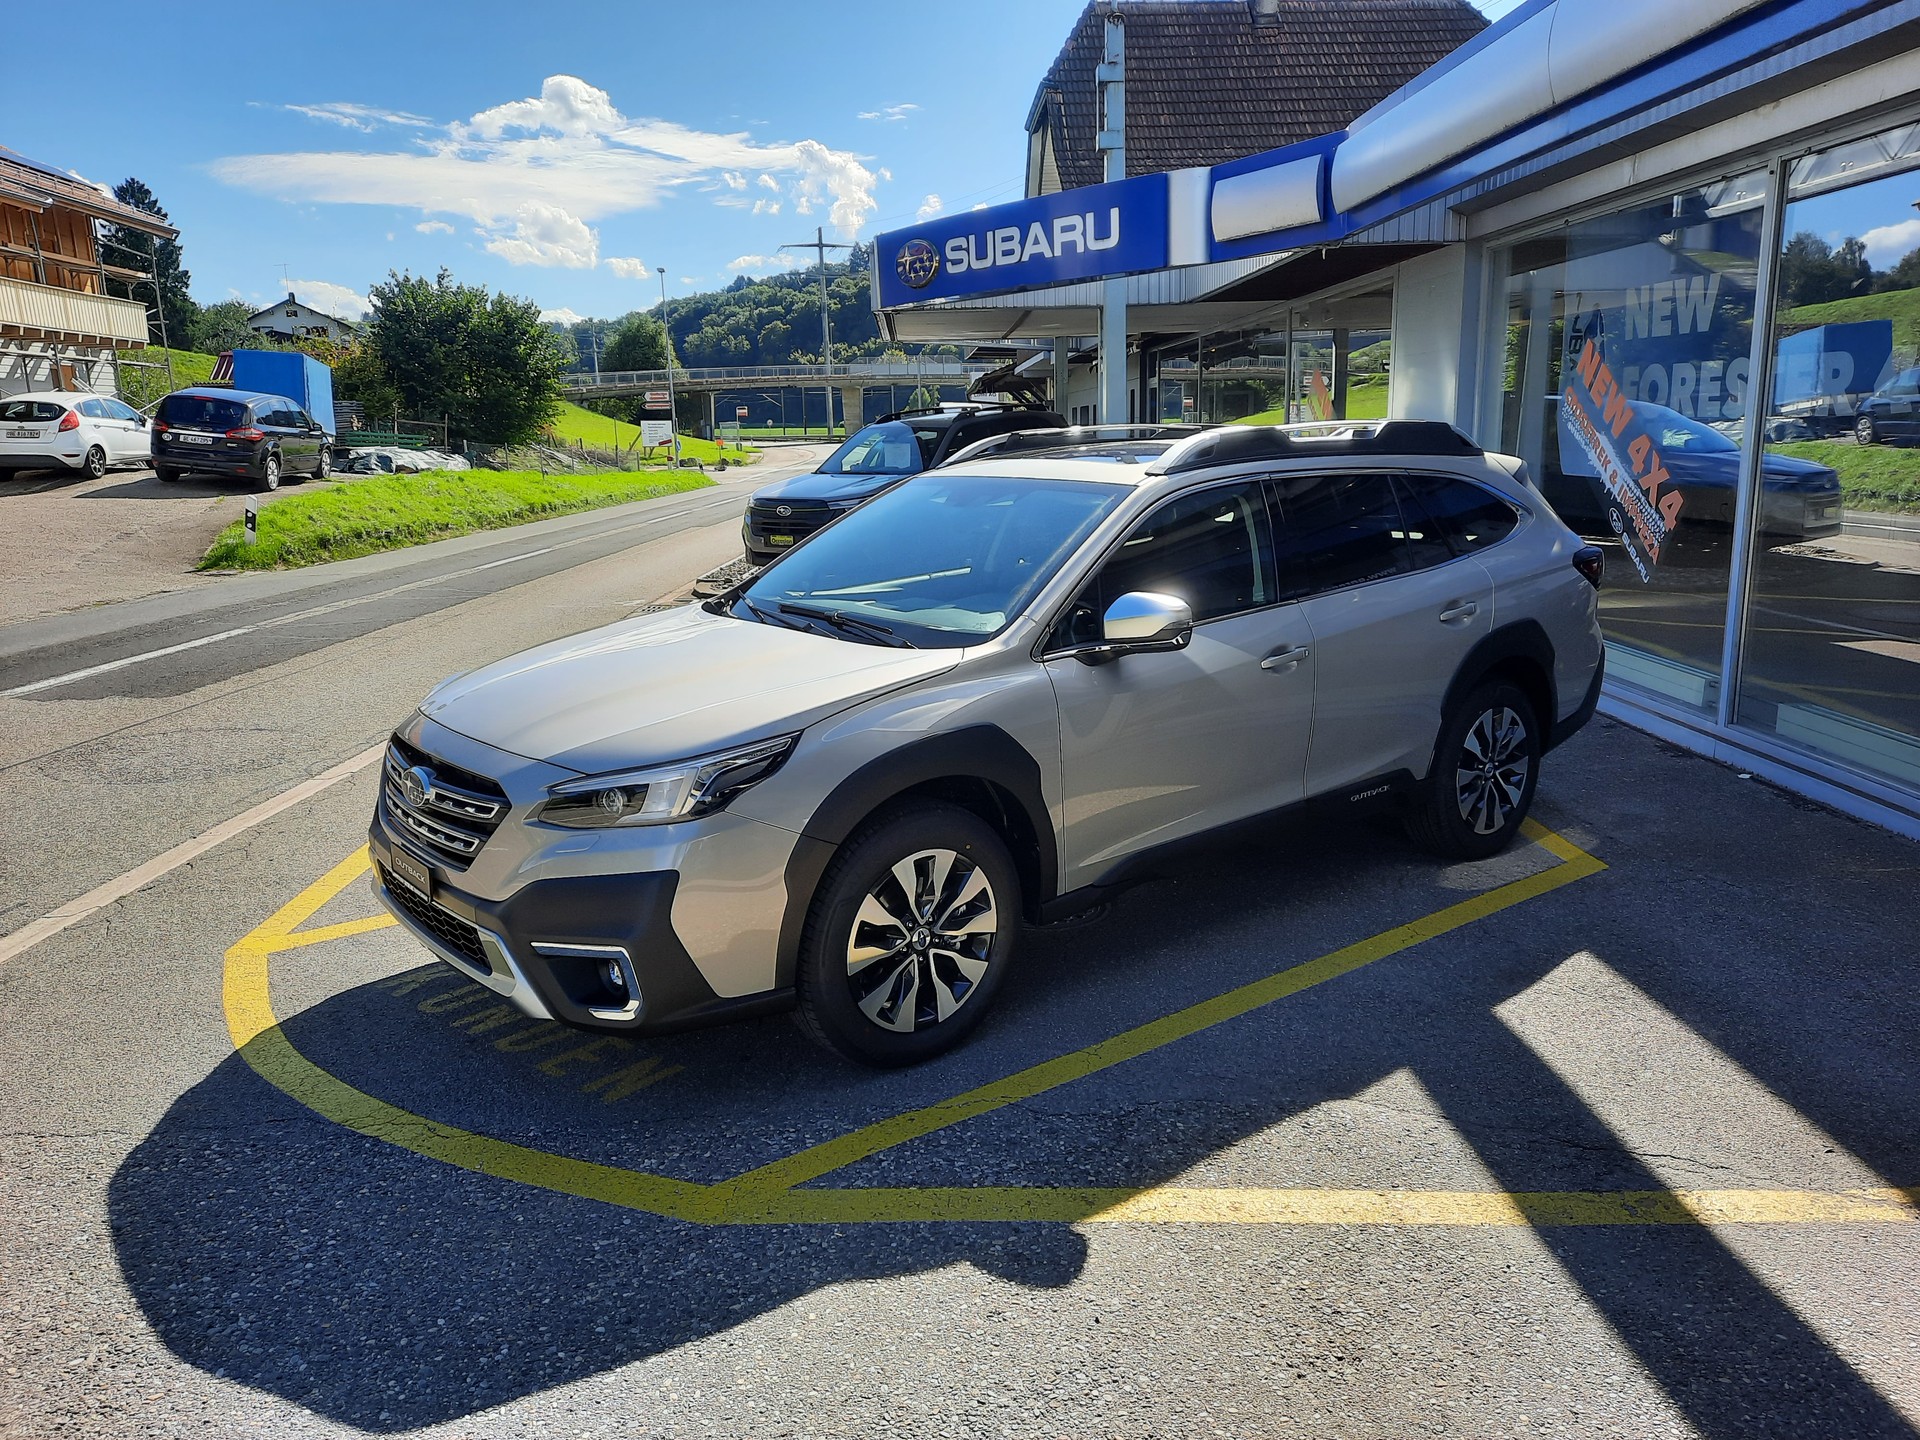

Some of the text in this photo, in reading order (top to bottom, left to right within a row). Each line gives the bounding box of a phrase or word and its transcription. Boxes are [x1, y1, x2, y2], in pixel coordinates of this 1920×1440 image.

[944, 207, 1120, 274] SUBARU
[1625, 272, 1722, 341] NEW
[1576, 338, 1684, 532] NEW 4X4
[1617, 483, 1660, 565] IMPREZA
[1622, 532, 1650, 584] SUBARU
[395, 857, 426, 884] OUTBACK
